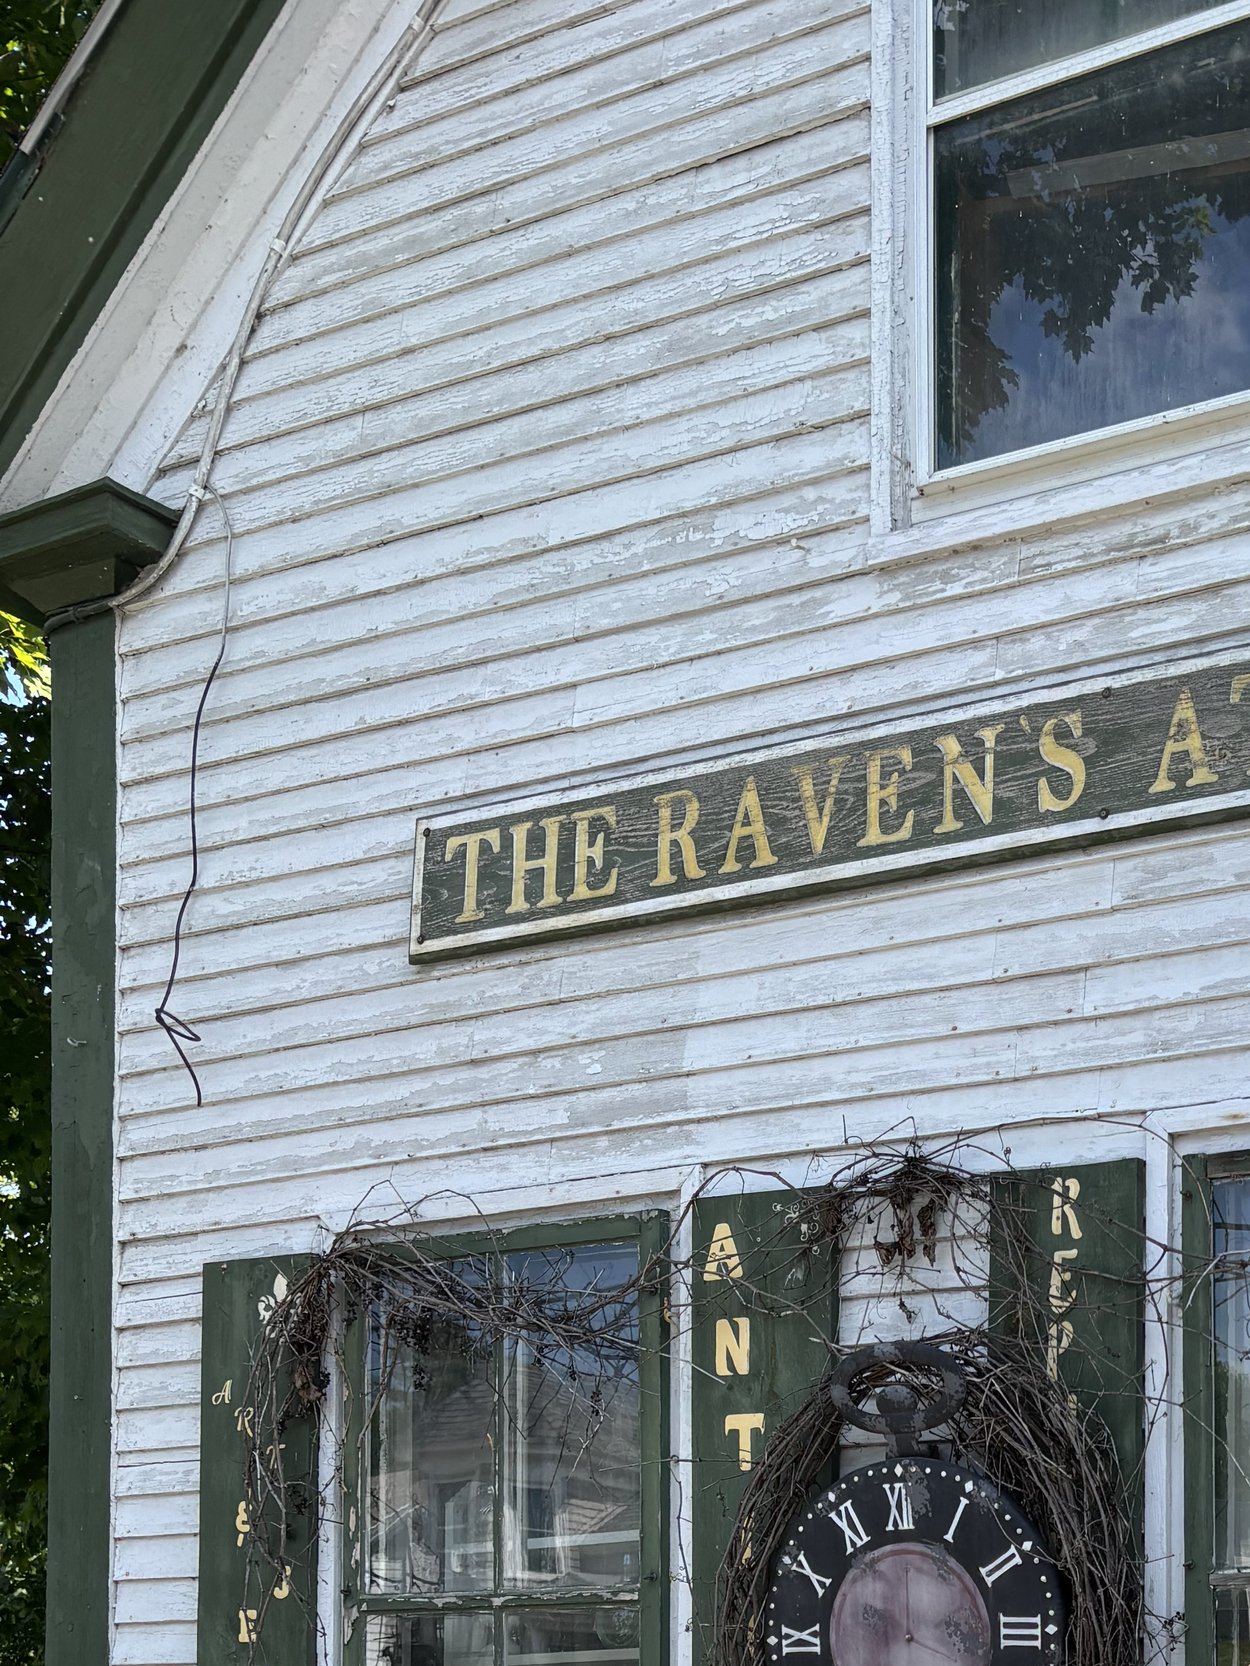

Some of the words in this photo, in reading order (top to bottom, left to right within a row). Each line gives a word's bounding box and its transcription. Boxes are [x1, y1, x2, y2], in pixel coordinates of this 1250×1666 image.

[445, 806, 620, 924] THE
[650, 710, 1086, 889] RAVEN'S
[828, 1499, 871, 1555] XI
[882, 1482, 915, 1531] XII
[791, 1550, 832, 1598] X
[978, 1544, 1023, 1588] II
[781, 1623, 821, 1656] IX
[999, 1612, 1042, 1650] III
